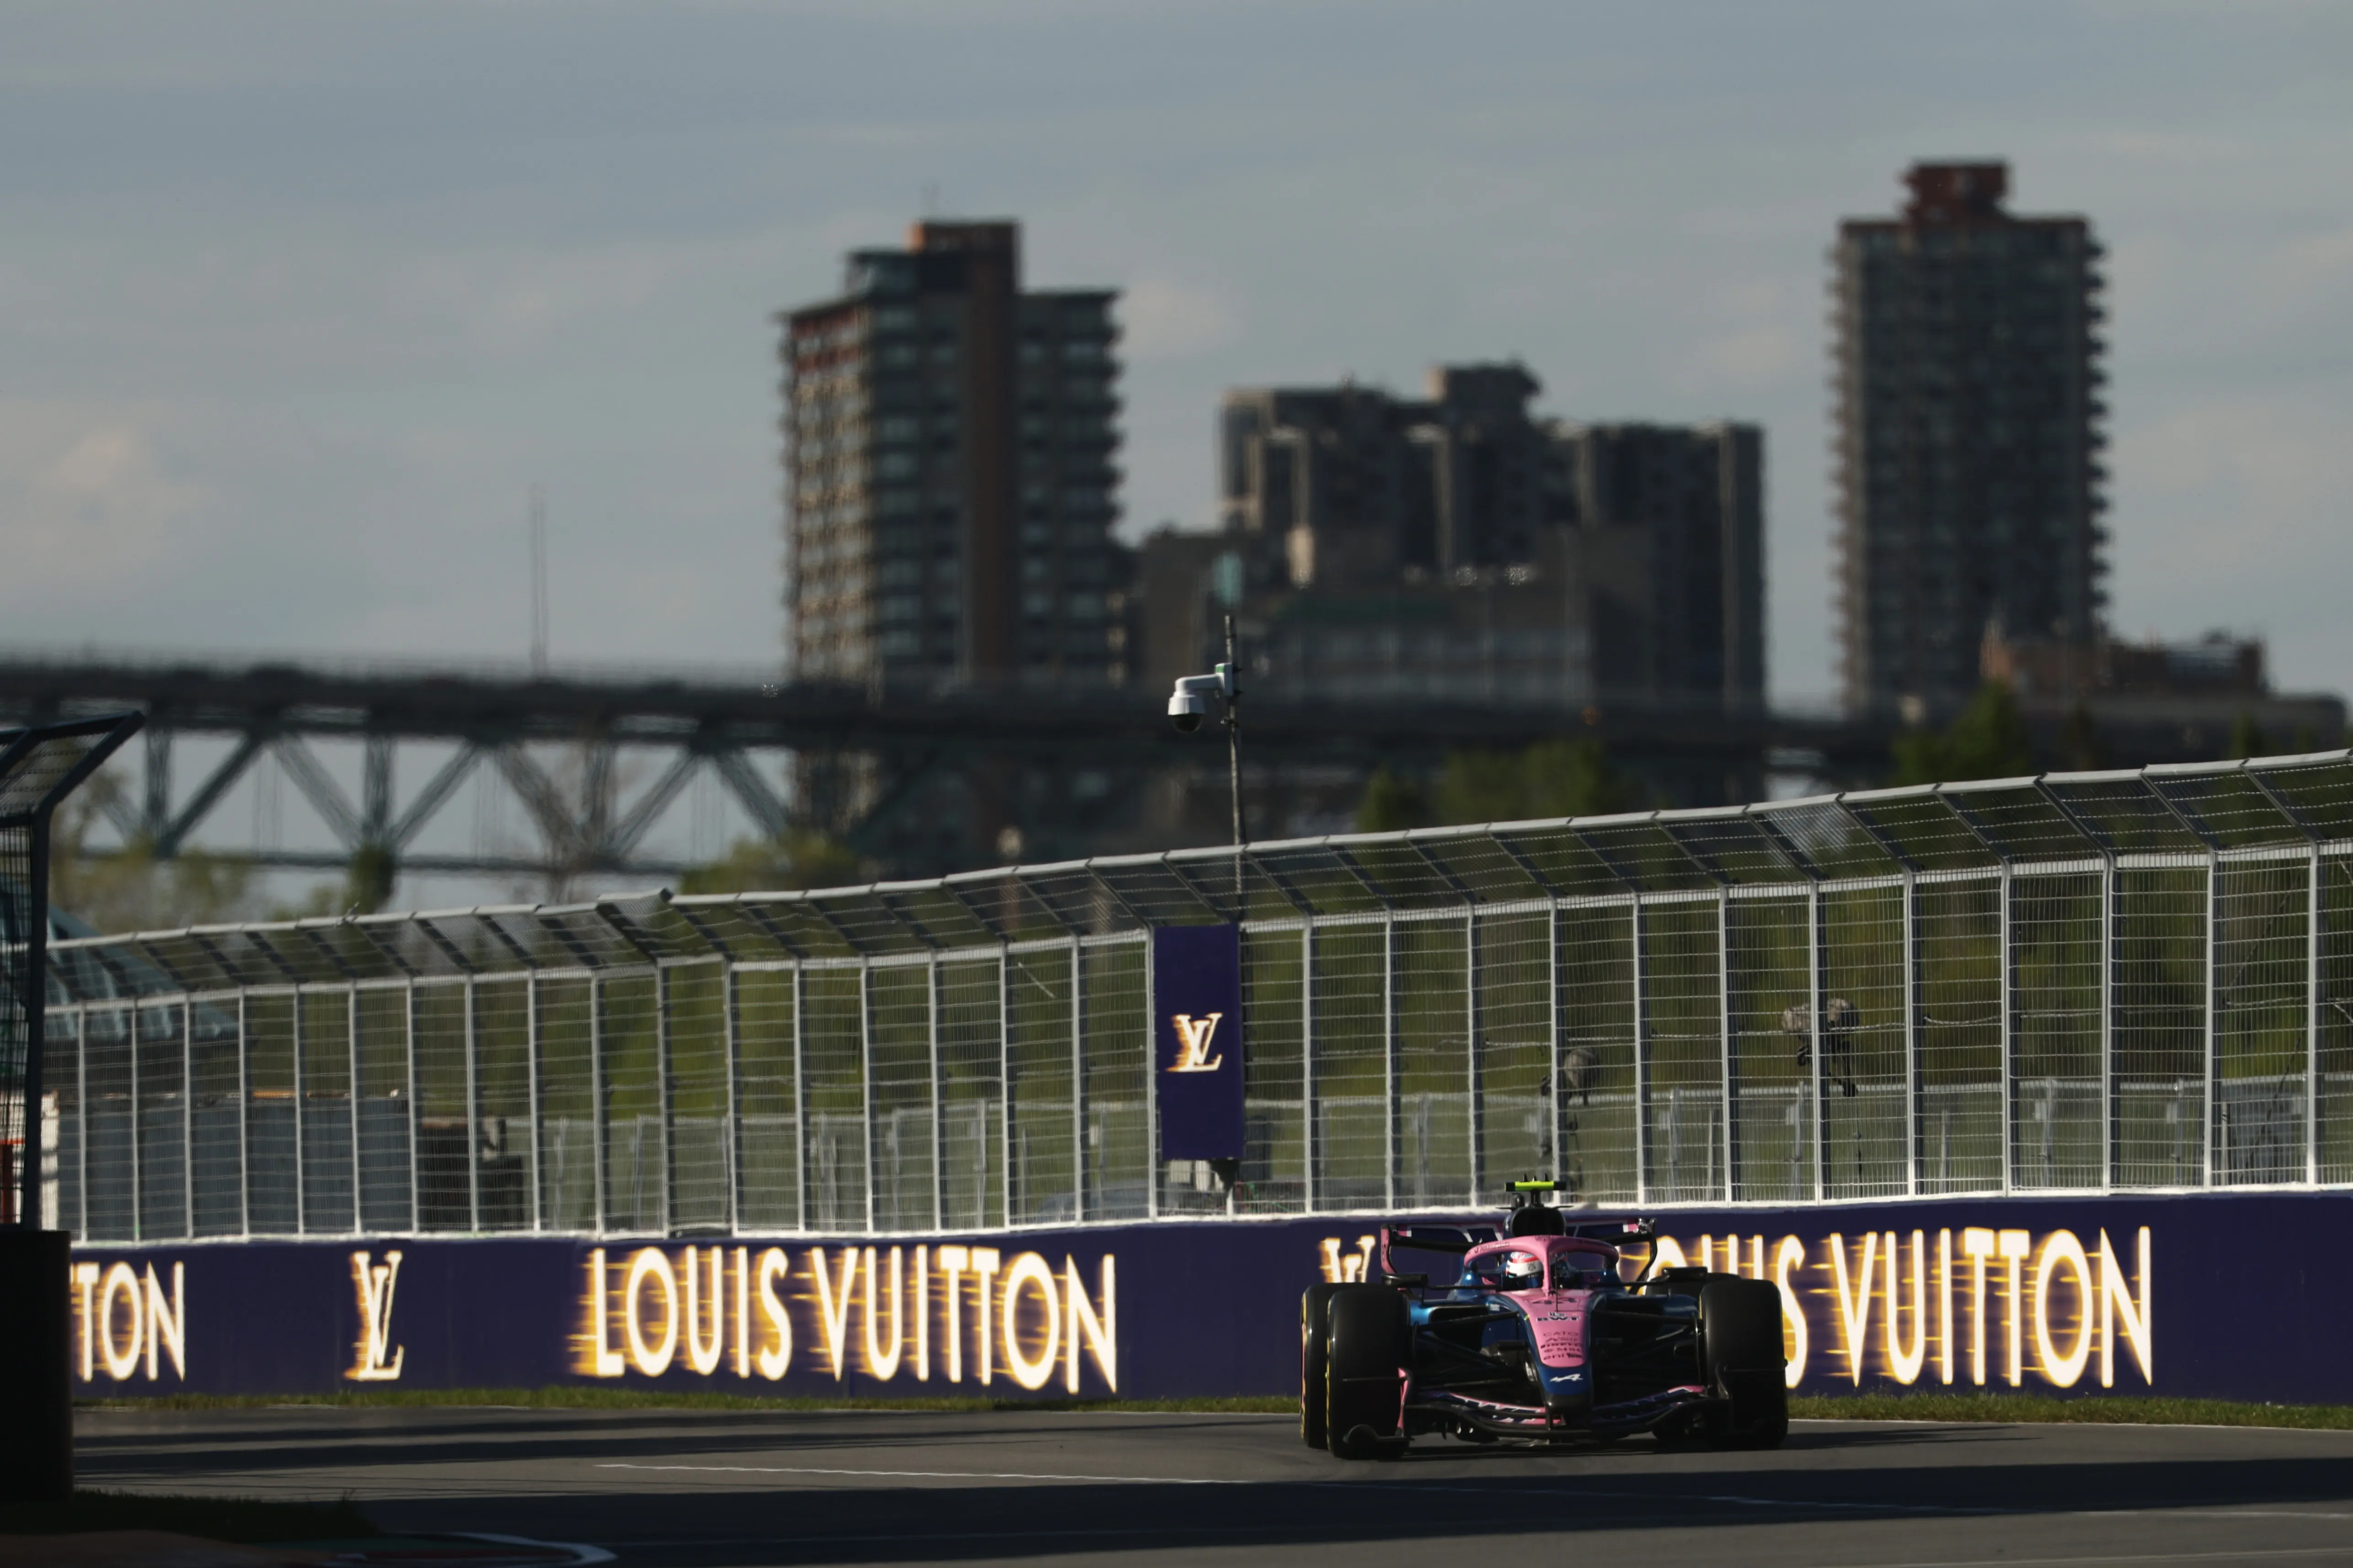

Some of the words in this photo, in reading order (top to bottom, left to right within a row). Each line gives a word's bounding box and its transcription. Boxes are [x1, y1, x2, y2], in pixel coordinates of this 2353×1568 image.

[70, 1260, 185, 1383] TON
[589, 1245, 792, 1381] LOUIS
[812, 1245, 1117, 1394] VUITTON
[1829, 1227, 2152, 1388] VUITTON
